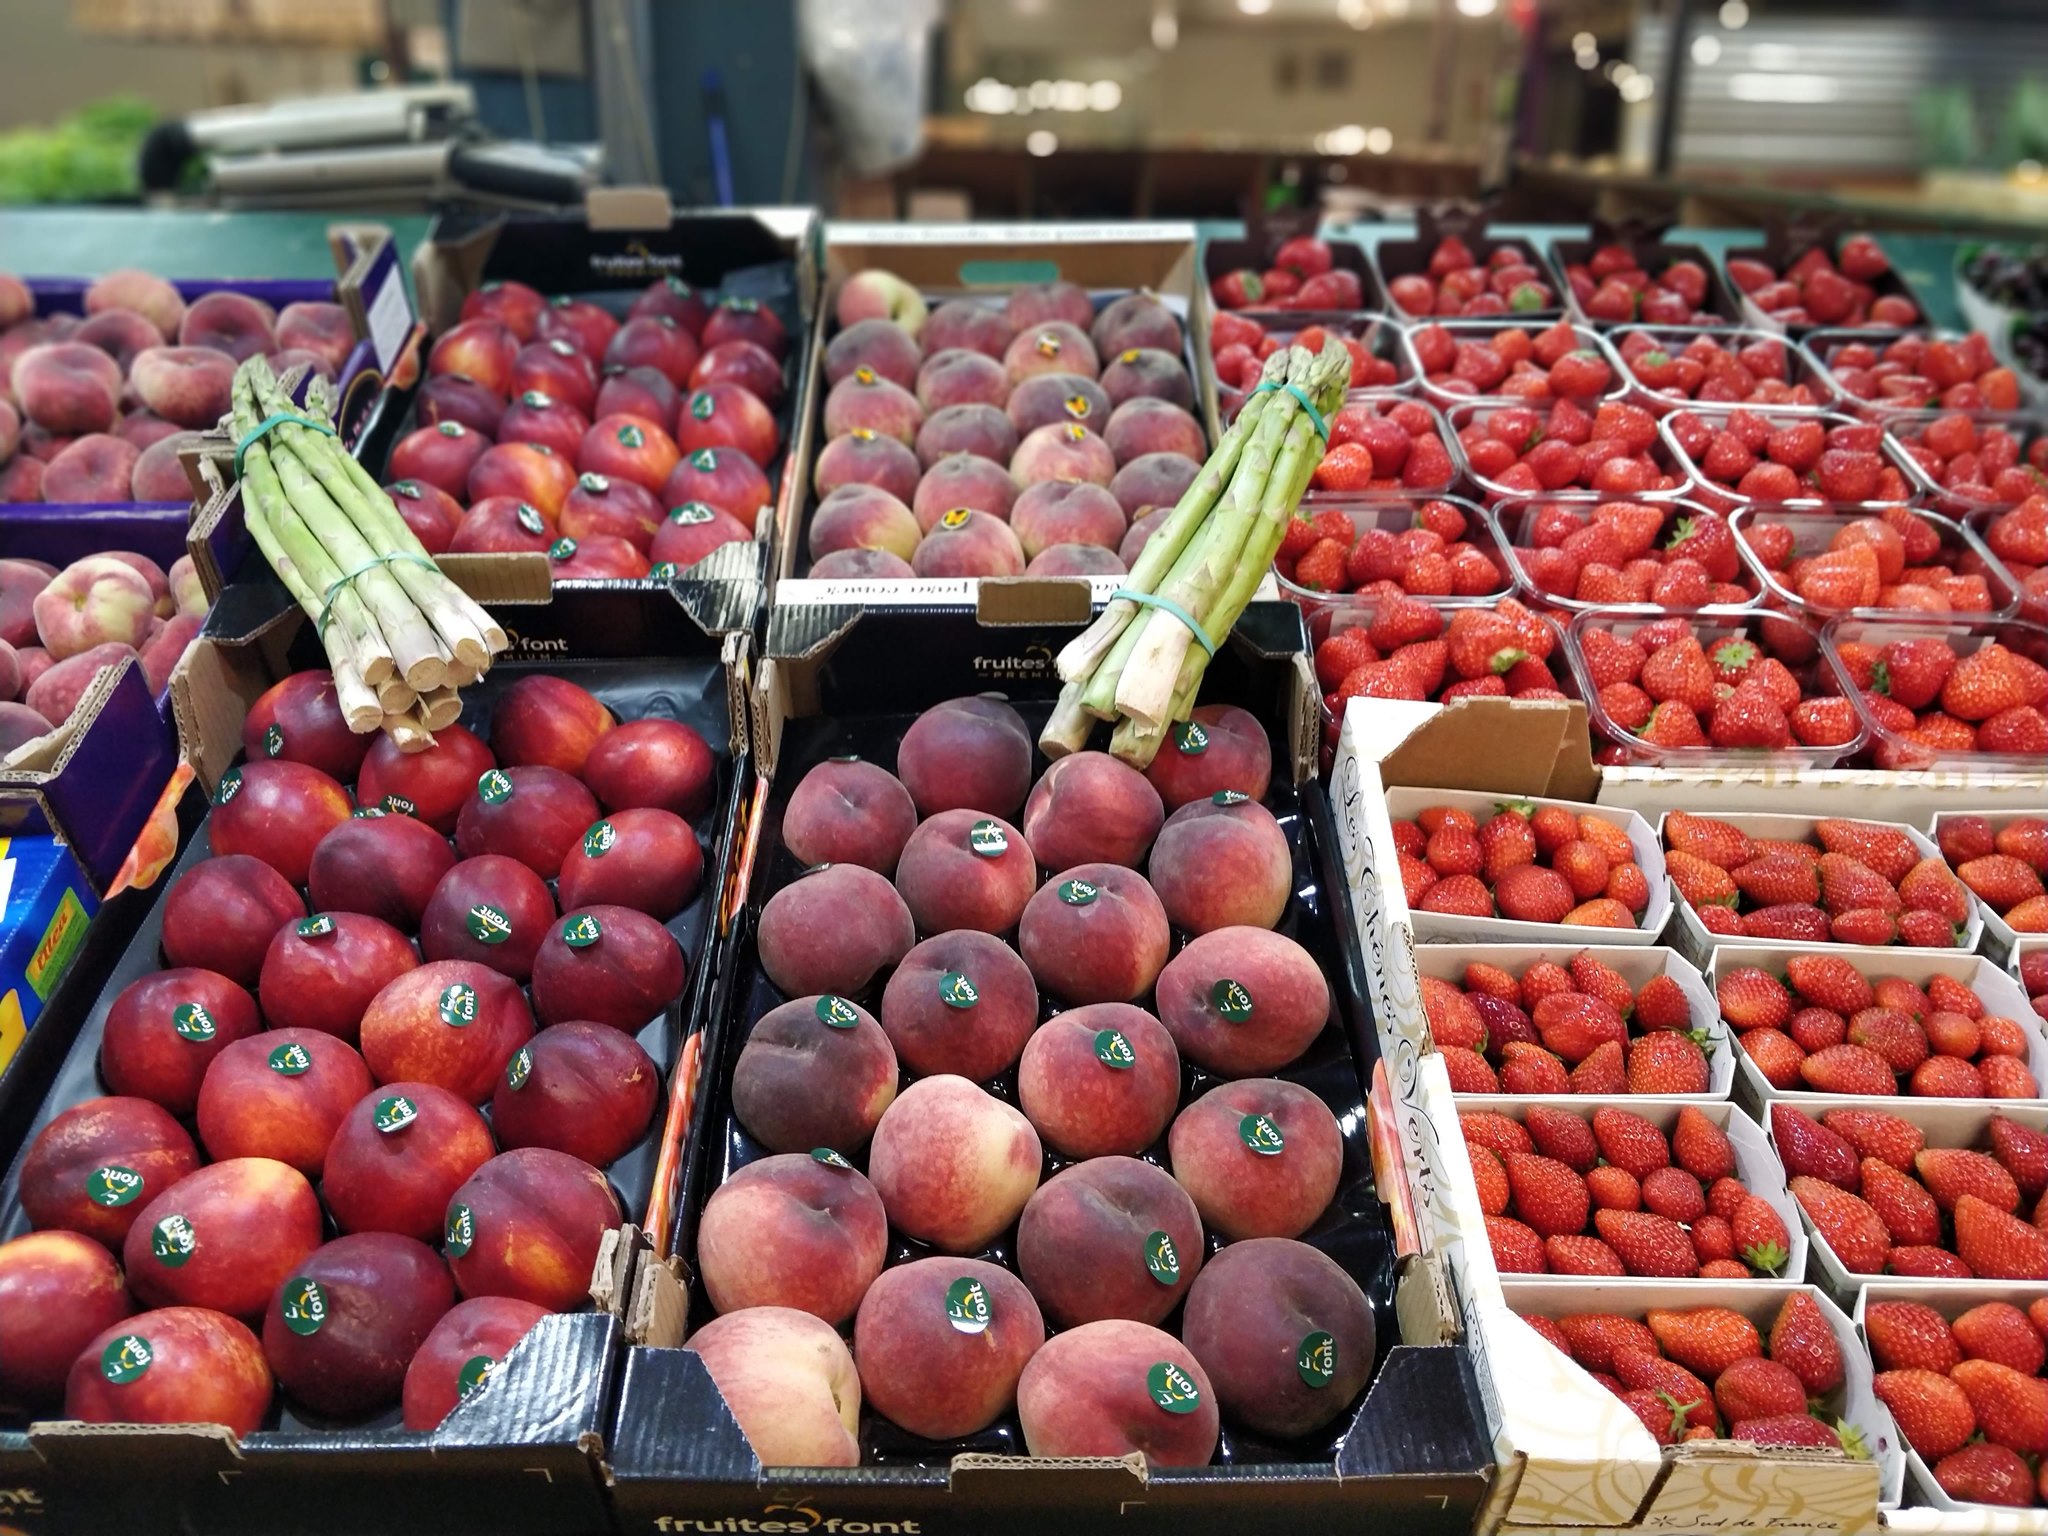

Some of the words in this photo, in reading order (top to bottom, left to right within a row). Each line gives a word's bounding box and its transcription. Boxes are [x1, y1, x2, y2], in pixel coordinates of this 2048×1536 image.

[521, 637, 568, 651] font
[973, 656, 1045, 670] fruites
[1188, 722, 1208, 747] font
[221, 779, 242, 804] font
[490, 769, 511, 793] font
[386, 794, 414, 813] font
[599, 823, 617, 851] font
[1071, 879, 1097, 897] font
[479, 904, 510, 928] font
[580, 914, 599, 939] font
[955, 974, 979, 1003] font
[1340, 756, 1362, 852] Les
[1397, 1038, 1440, 1208] Verts
[462, 990, 475, 1020] font
[830, 996, 858, 1022] font
[1228, 981, 1253, 1012] font
[192, 1002, 215, 1034] font
[289, 1044, 310, 1069] font
[519, 1048, 531, 1074] font
[1112, 1031, 1135, 1063] font
[1254, 1116, 1284, 1147] font
[99, 1167, 140, 1188] font
[171, 1214, 194, 1255] font
[460, 1207, 472, 1246] font
[1160, 1234, 1181, 1274] font
[304, 1281, 325, 1321] font
[969, 1282, 990, 1323] font
[123, 1335, 151, 1366] font
[1321, 1337, 1334, 1377] font
[1164, 1362, 1199, 1401] font
[653, 1516, 809, 1533] fruites
[822, 1518, 921, 1535] font
[1680, 1514, 1729, 1528] Sud
[1732, 1518, 1756, 1528] de
[1765, 1517, 1840, 1530] France
